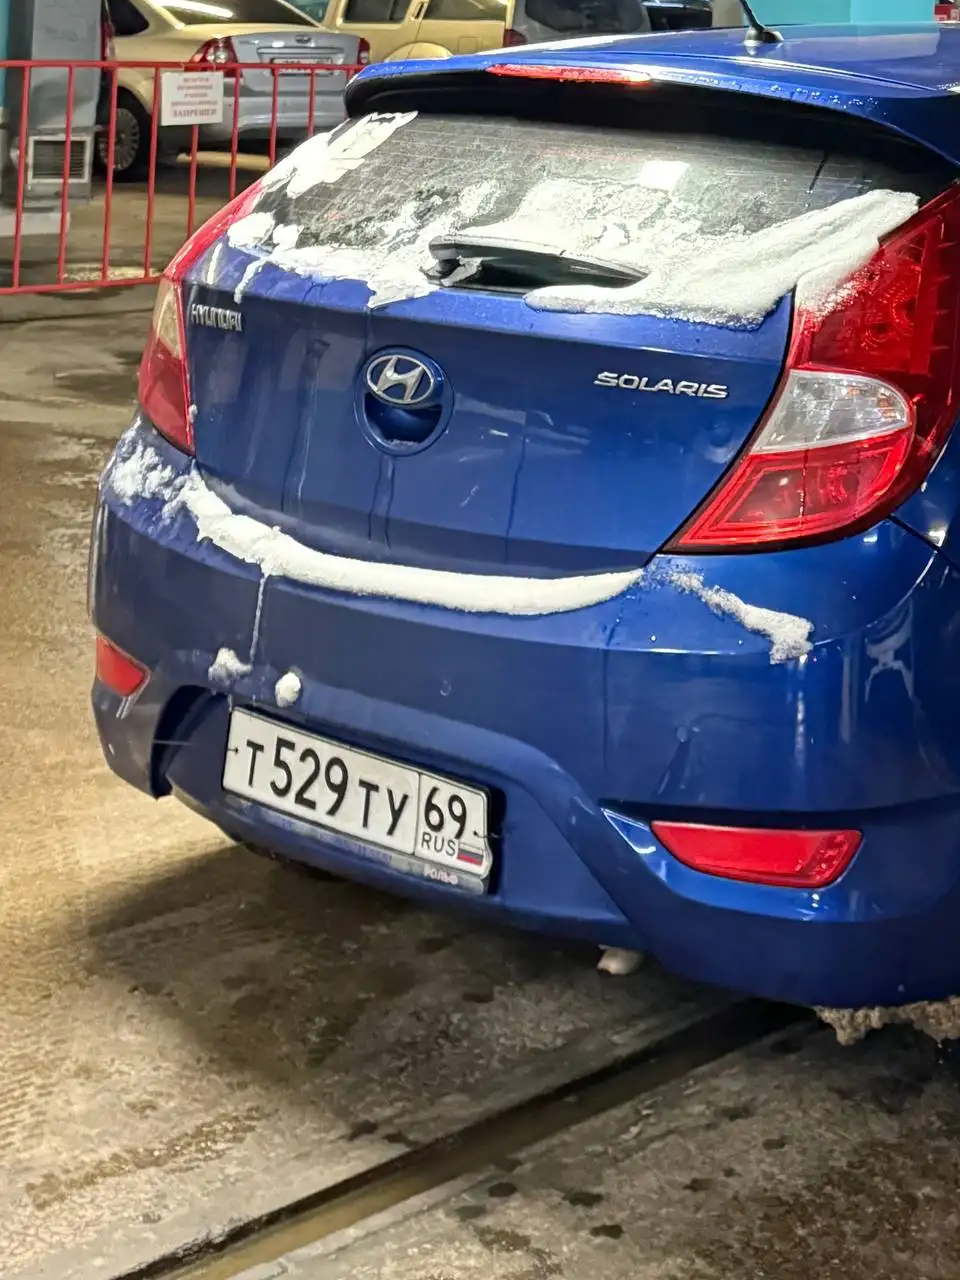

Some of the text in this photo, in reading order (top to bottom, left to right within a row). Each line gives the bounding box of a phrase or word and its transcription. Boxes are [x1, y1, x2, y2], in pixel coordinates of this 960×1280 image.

[191, 303, 243, 332] HYUNDAI
[593, 371, 729, 399] SOLARIS
[424, 786, 468, 840] 69
[420, 831, 457, 857] RUS
